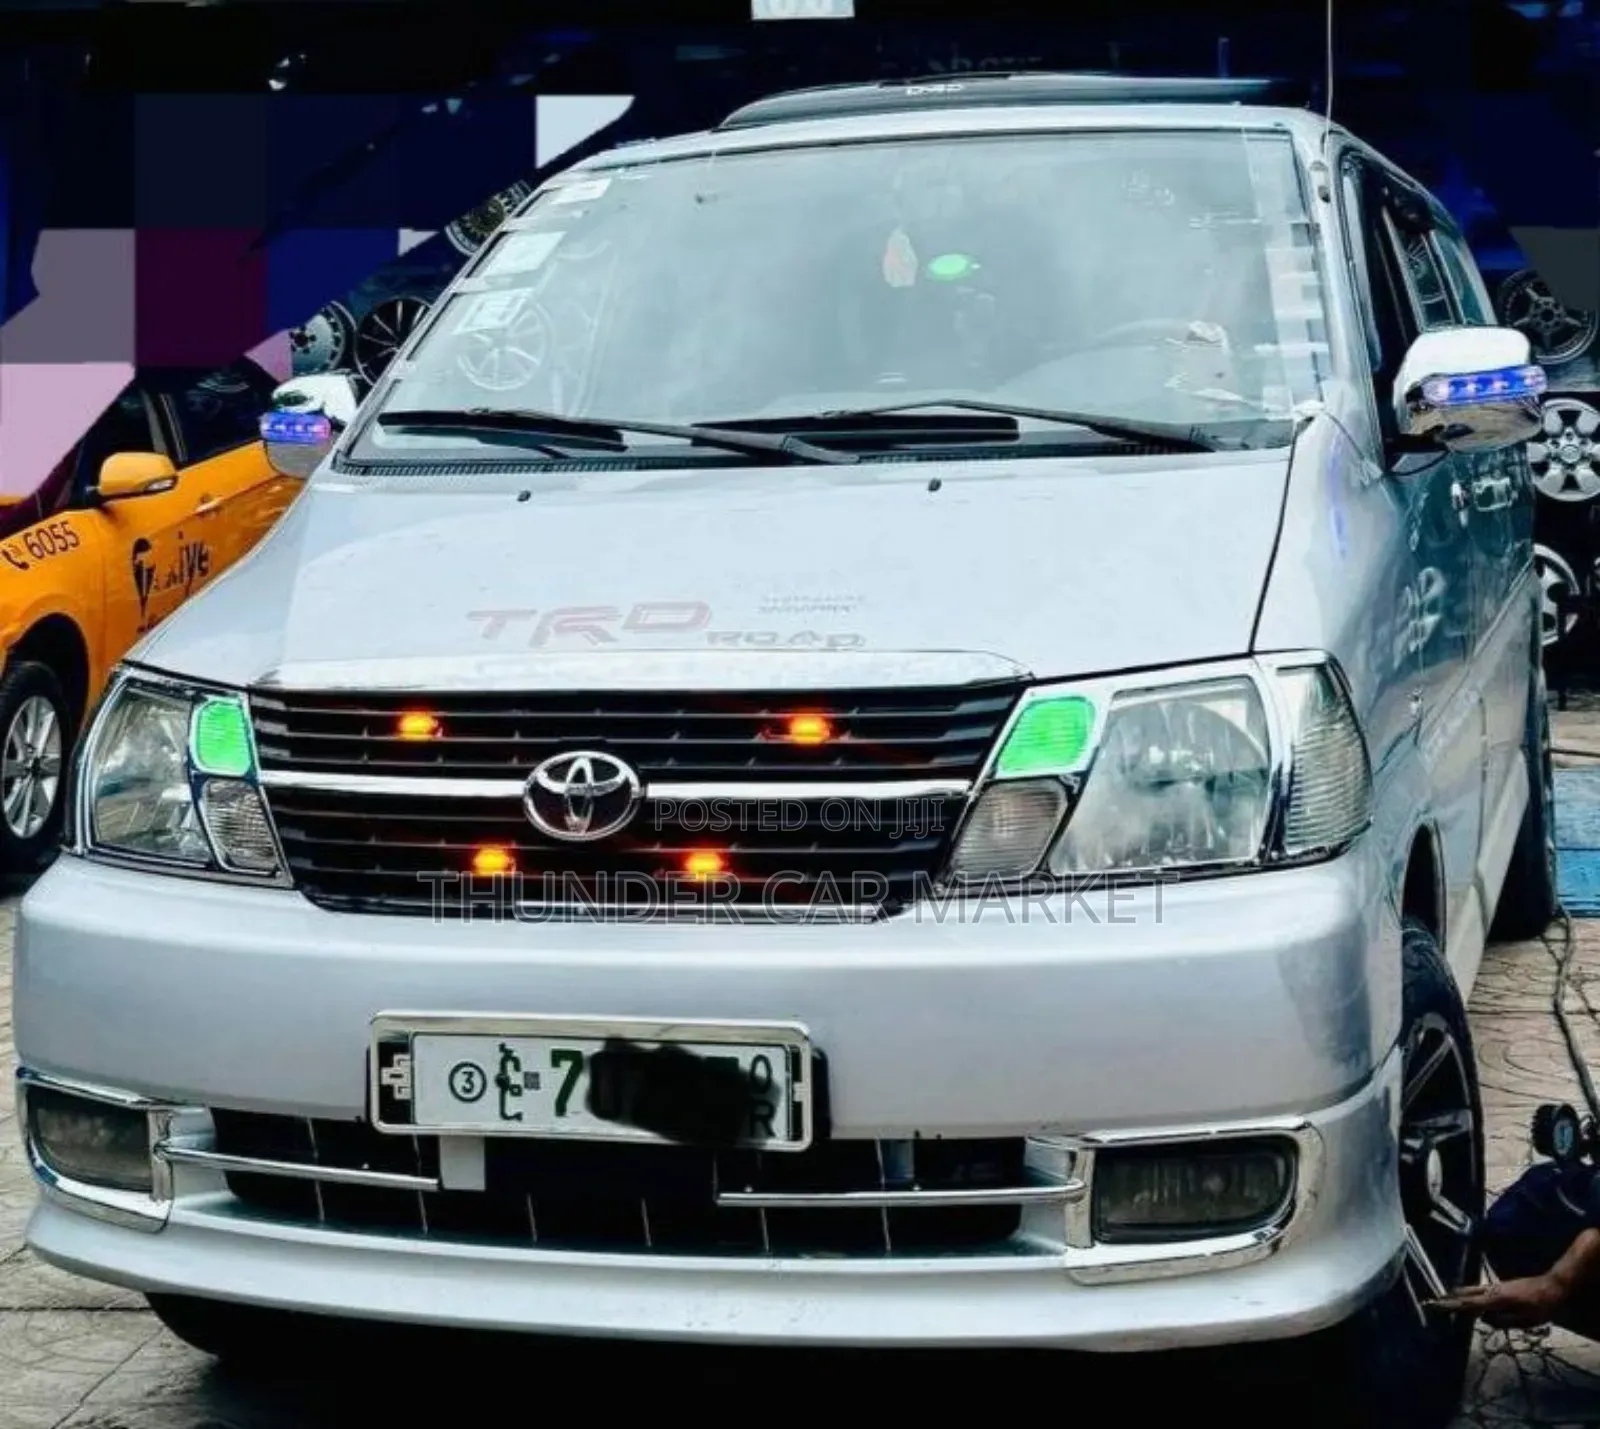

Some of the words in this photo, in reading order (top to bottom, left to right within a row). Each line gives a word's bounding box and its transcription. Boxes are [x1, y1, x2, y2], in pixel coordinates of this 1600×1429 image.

[23, 520, 80, 559] 6055
[465, 600, 712, 647] TRD
[706, 630, 867, 648] ROAD
